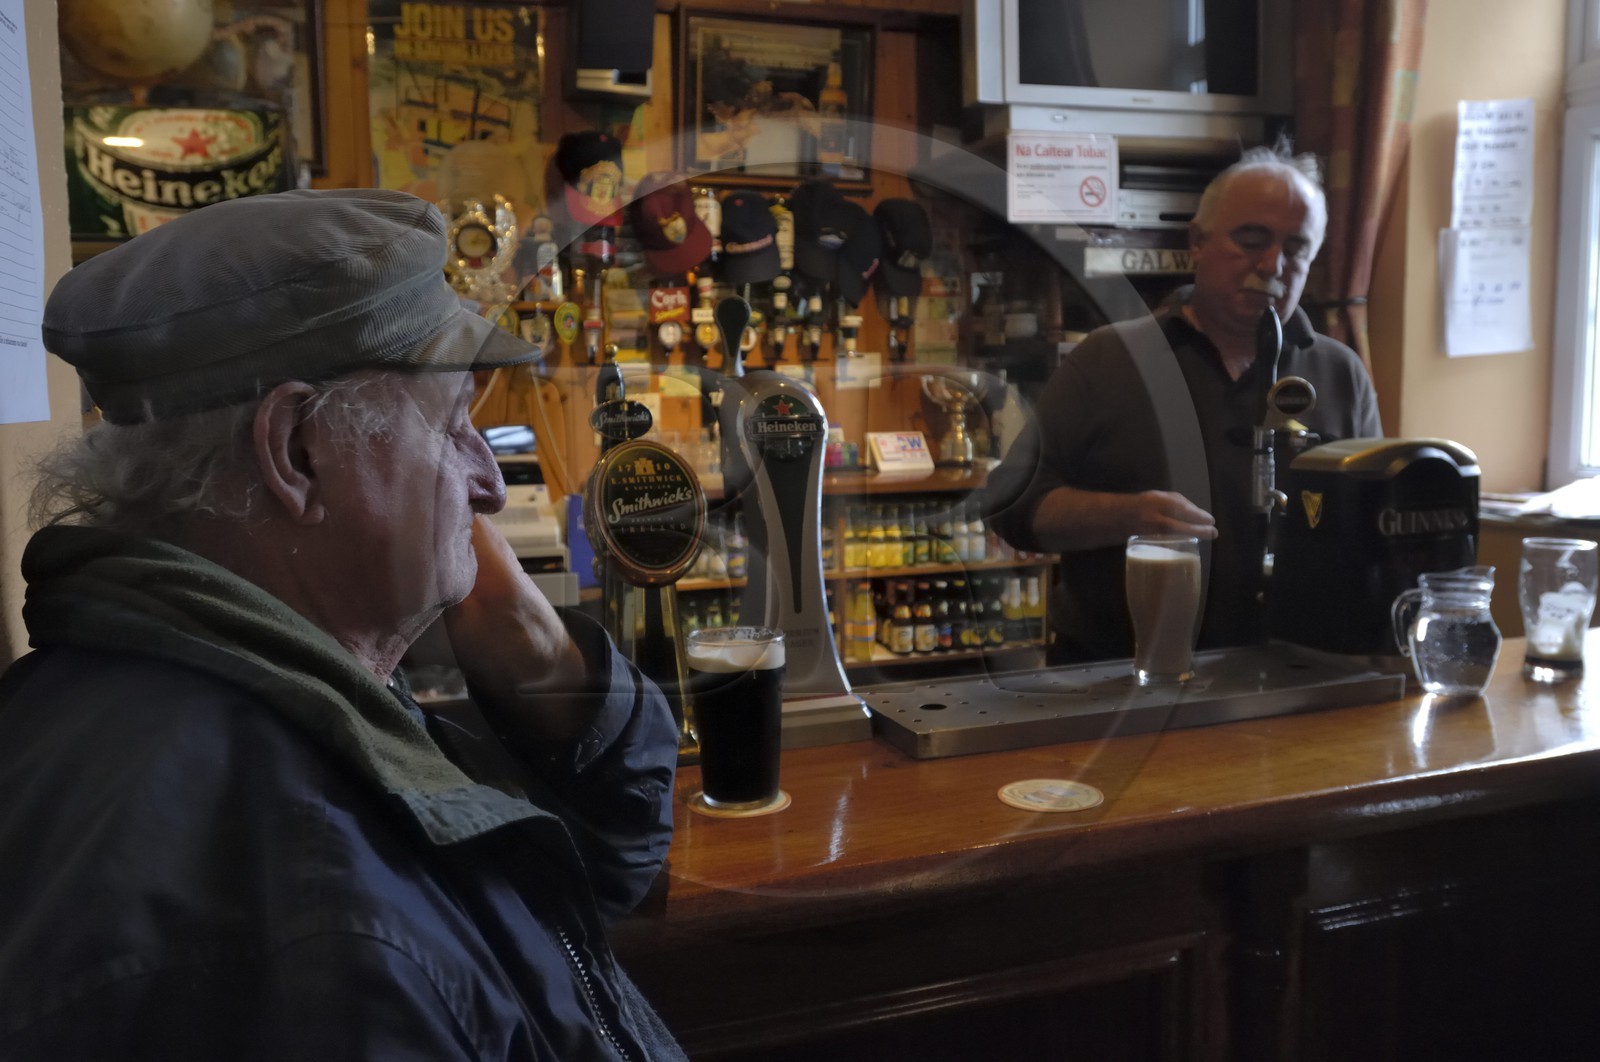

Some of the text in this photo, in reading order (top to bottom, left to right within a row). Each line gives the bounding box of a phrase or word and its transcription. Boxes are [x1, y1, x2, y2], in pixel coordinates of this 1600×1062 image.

[392, 2, 515, 42] JOIN US
[86, 144, 284, 209] Heineken
[756, 420, 818, 434] Heineken
[607, 486, 693, 525] Smithwick's
[621, 522, 686, 535] IRELAND
